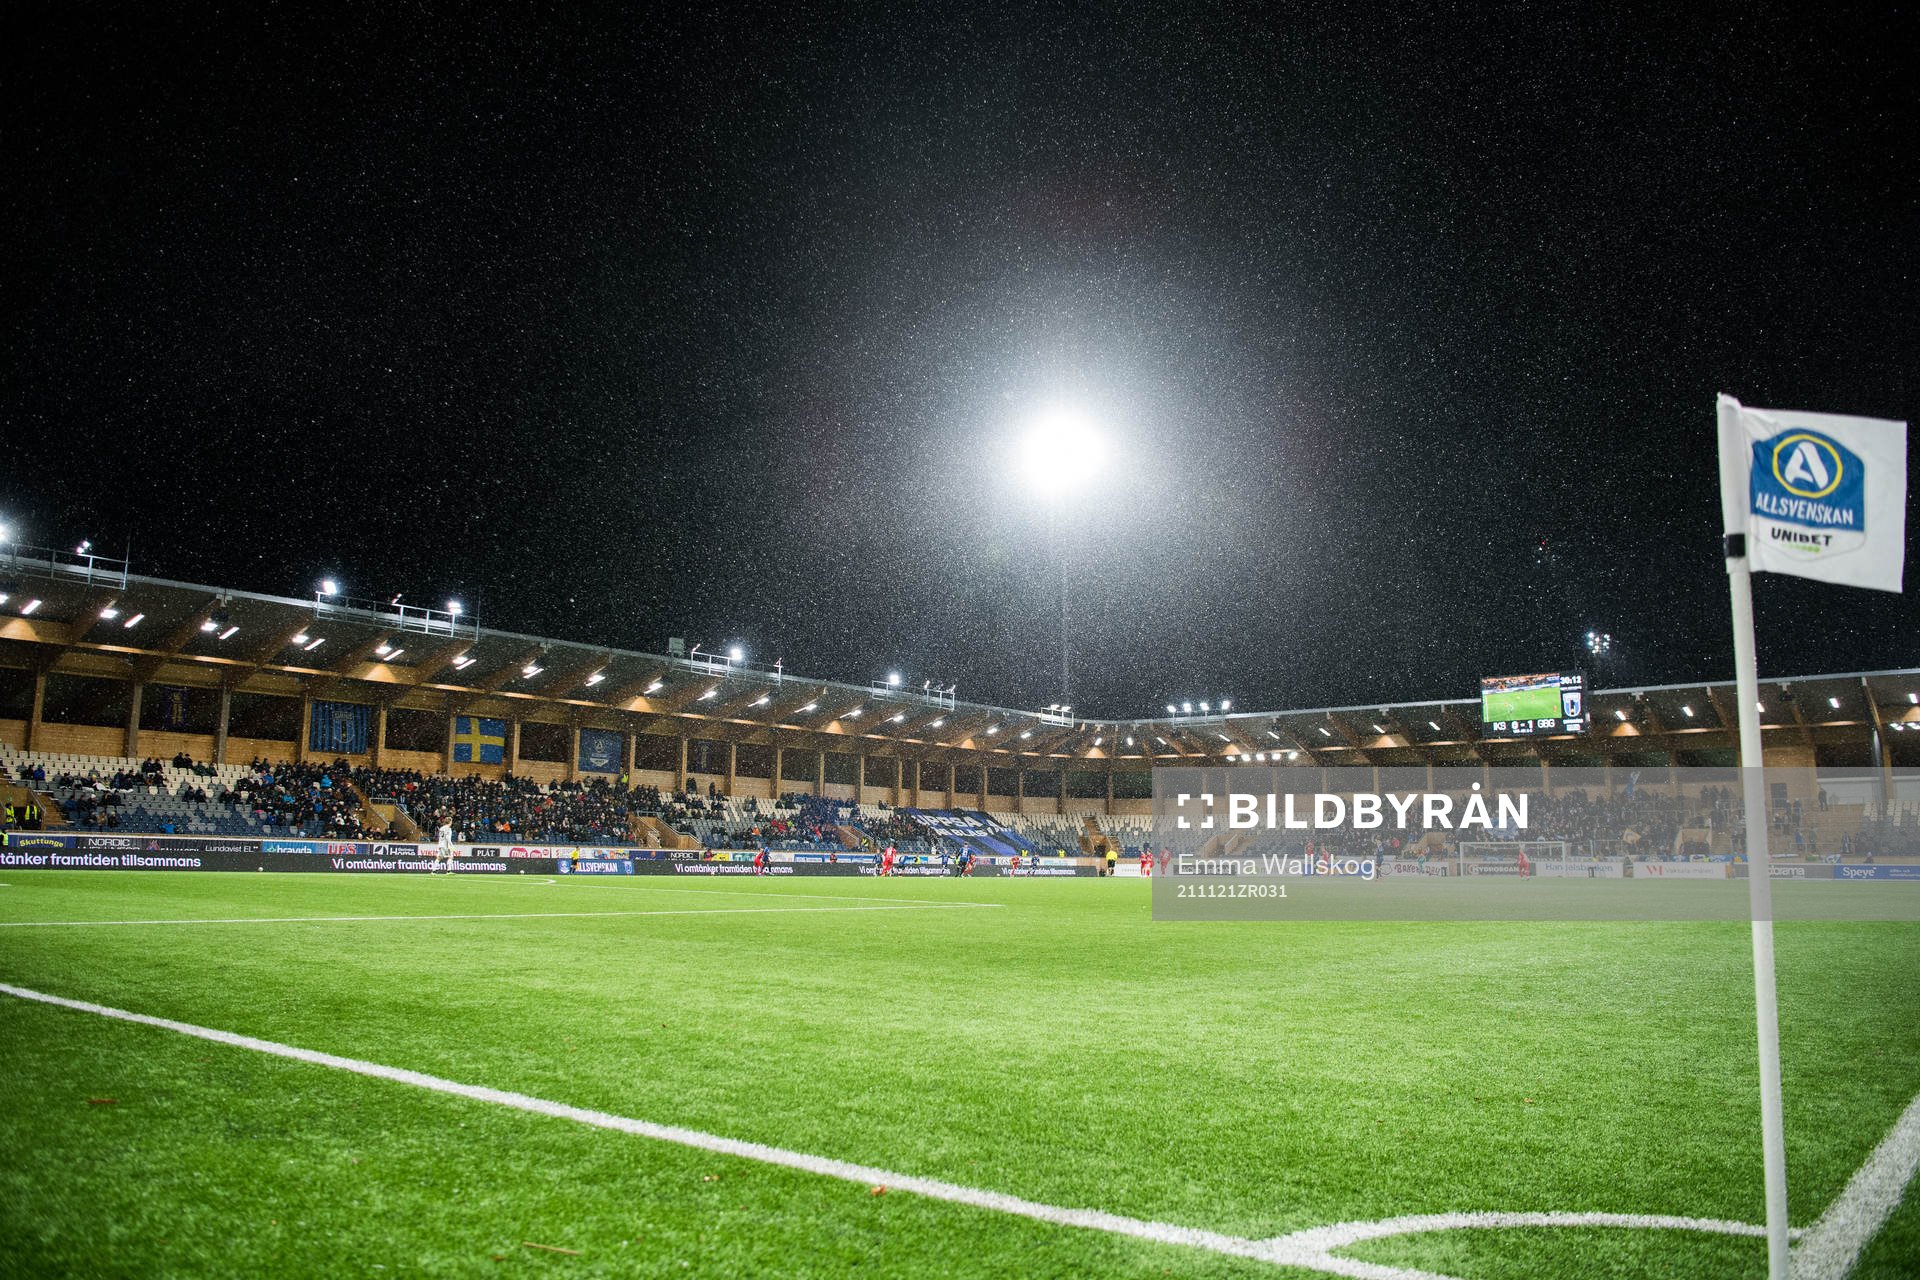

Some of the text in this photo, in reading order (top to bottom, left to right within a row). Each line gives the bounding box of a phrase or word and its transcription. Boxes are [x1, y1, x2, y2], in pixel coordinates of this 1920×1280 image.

[1755, 491, 1853, 525] ALLSVENSKAN
[1771, 527, 1832, 546] UNIBET
[88, 838, 130, 847] NORDIC
[50, 853, 119, 866] framtiden
[121, 854, 202, 867] tillsammans
[332, 858, 344, 870] Vi
[345, 858, 396, 870] omtänker
[449, 860, 507, 871] illsammans
[675, 863, 684, 873] Vi
[1472, 865, 1523, 873] HYDROSCAN
